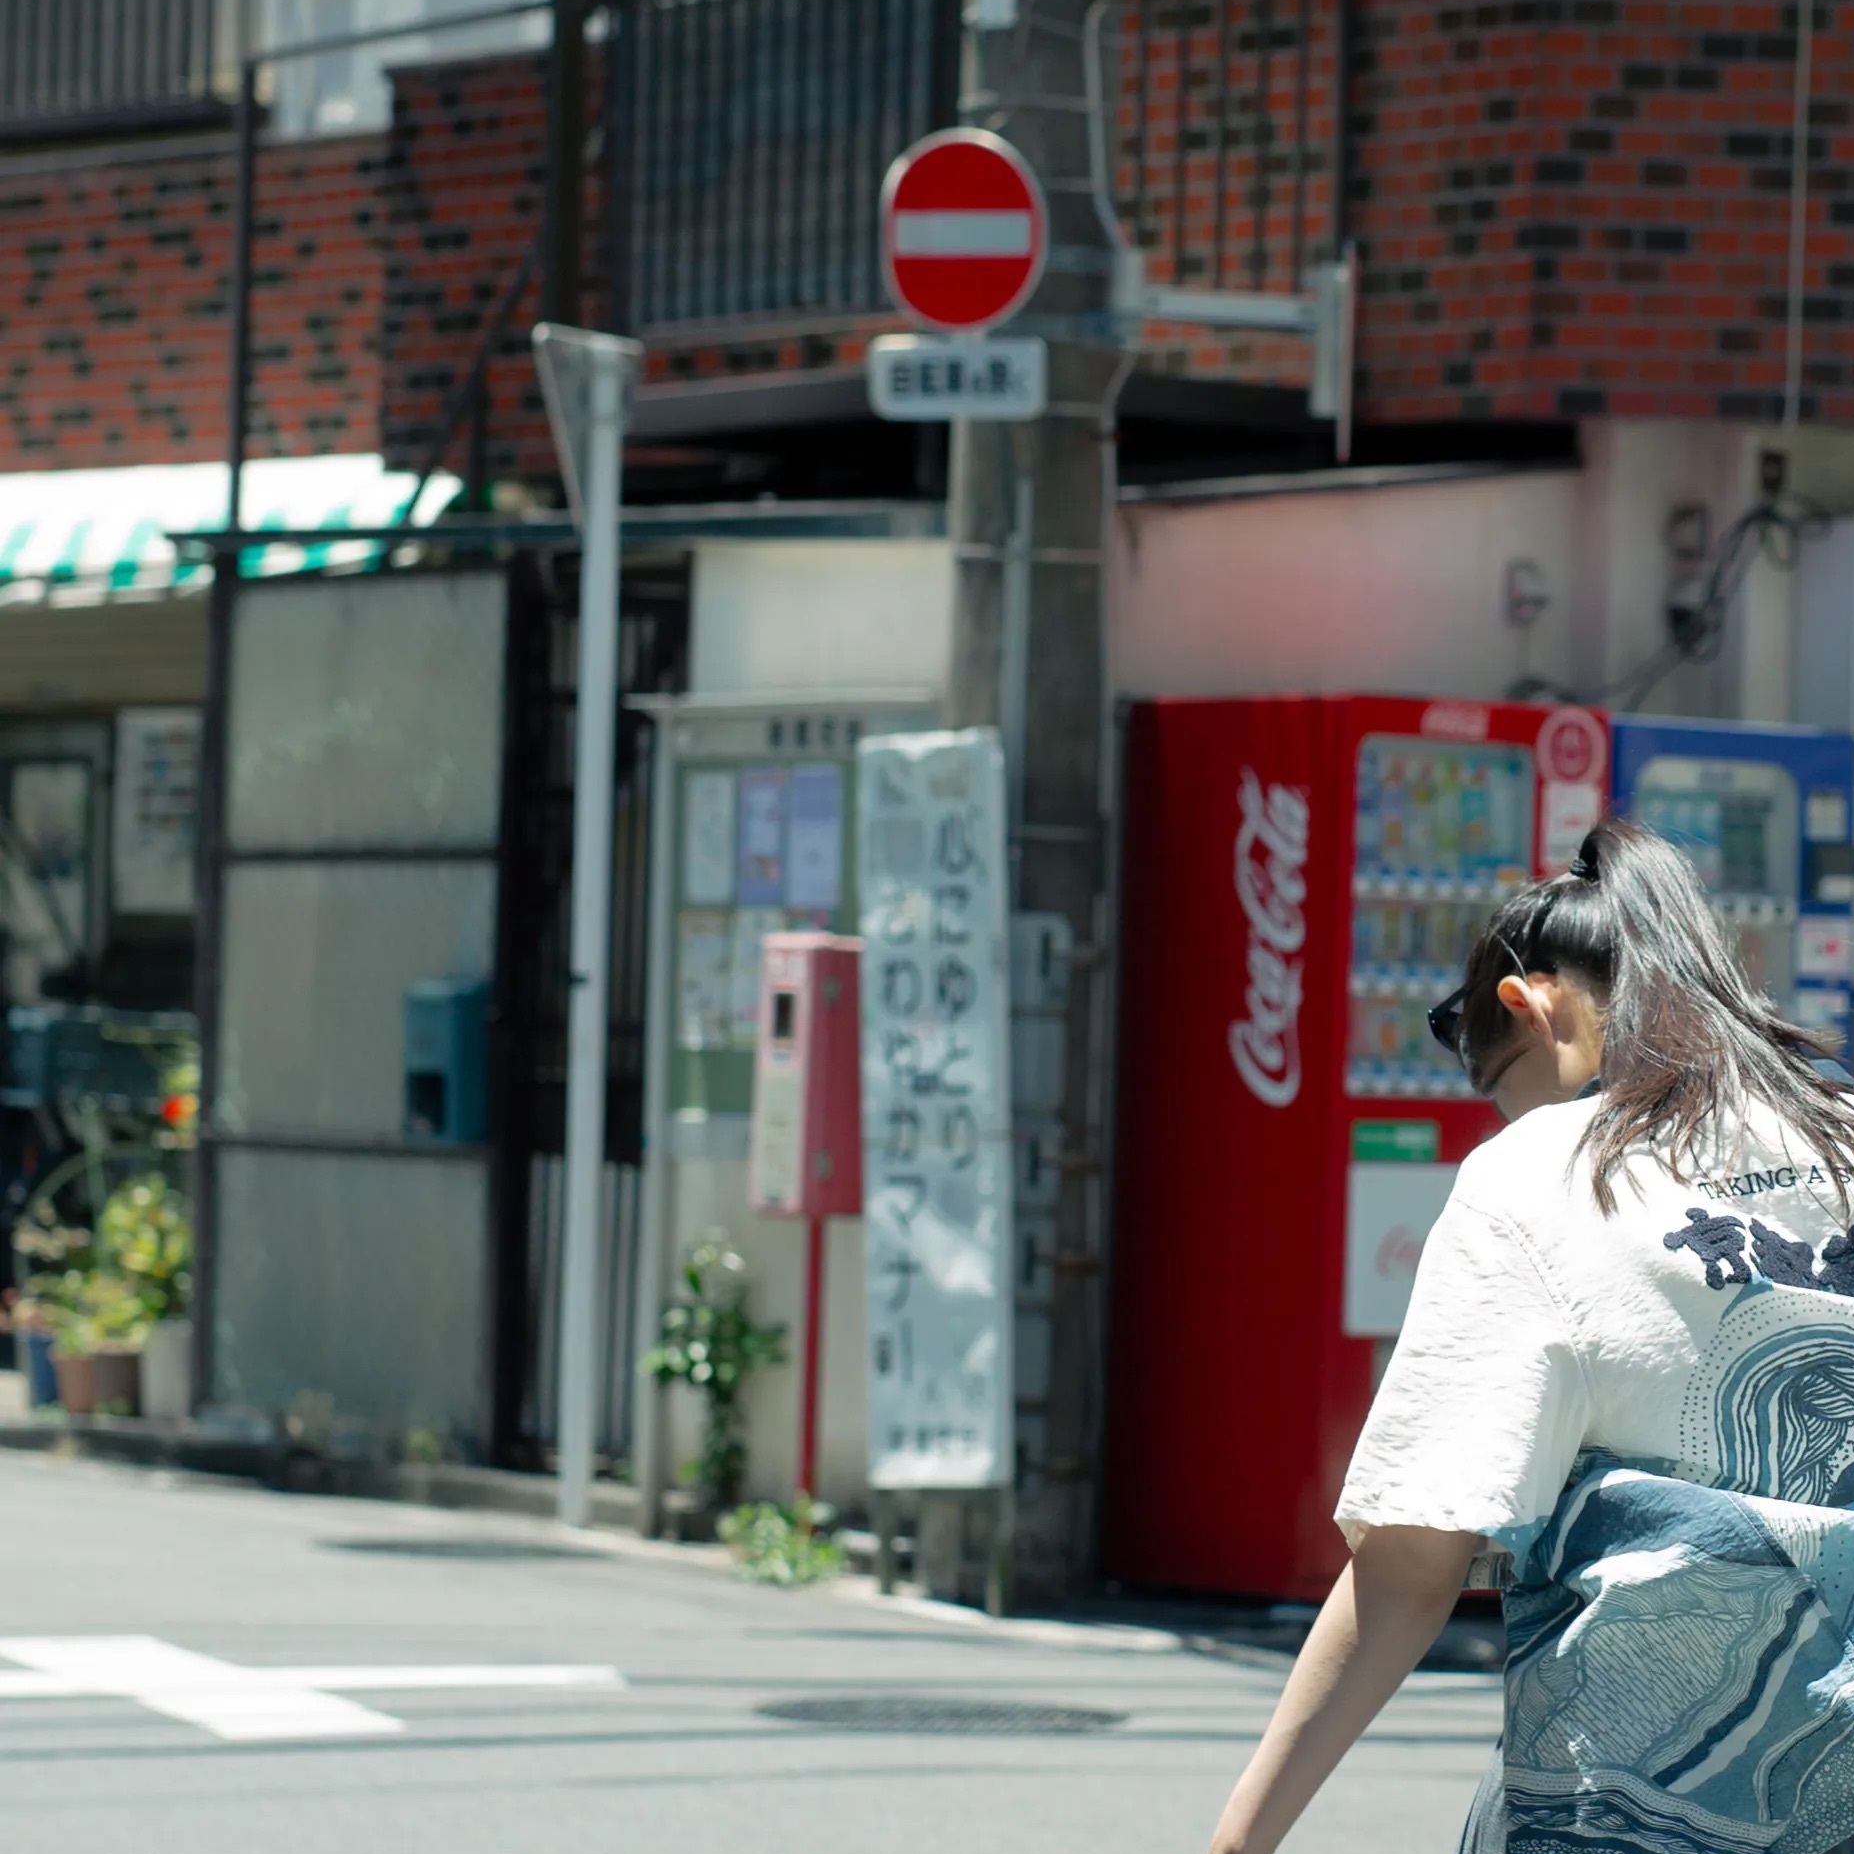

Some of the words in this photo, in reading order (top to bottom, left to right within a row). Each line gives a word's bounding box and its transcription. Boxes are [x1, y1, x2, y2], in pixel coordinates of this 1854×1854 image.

[1228, 765, 1310, 1109] Coca-Cola
[1697, 1167, 1797, 1200] TAKING
[1807, 1165, 1827, 1184] A
